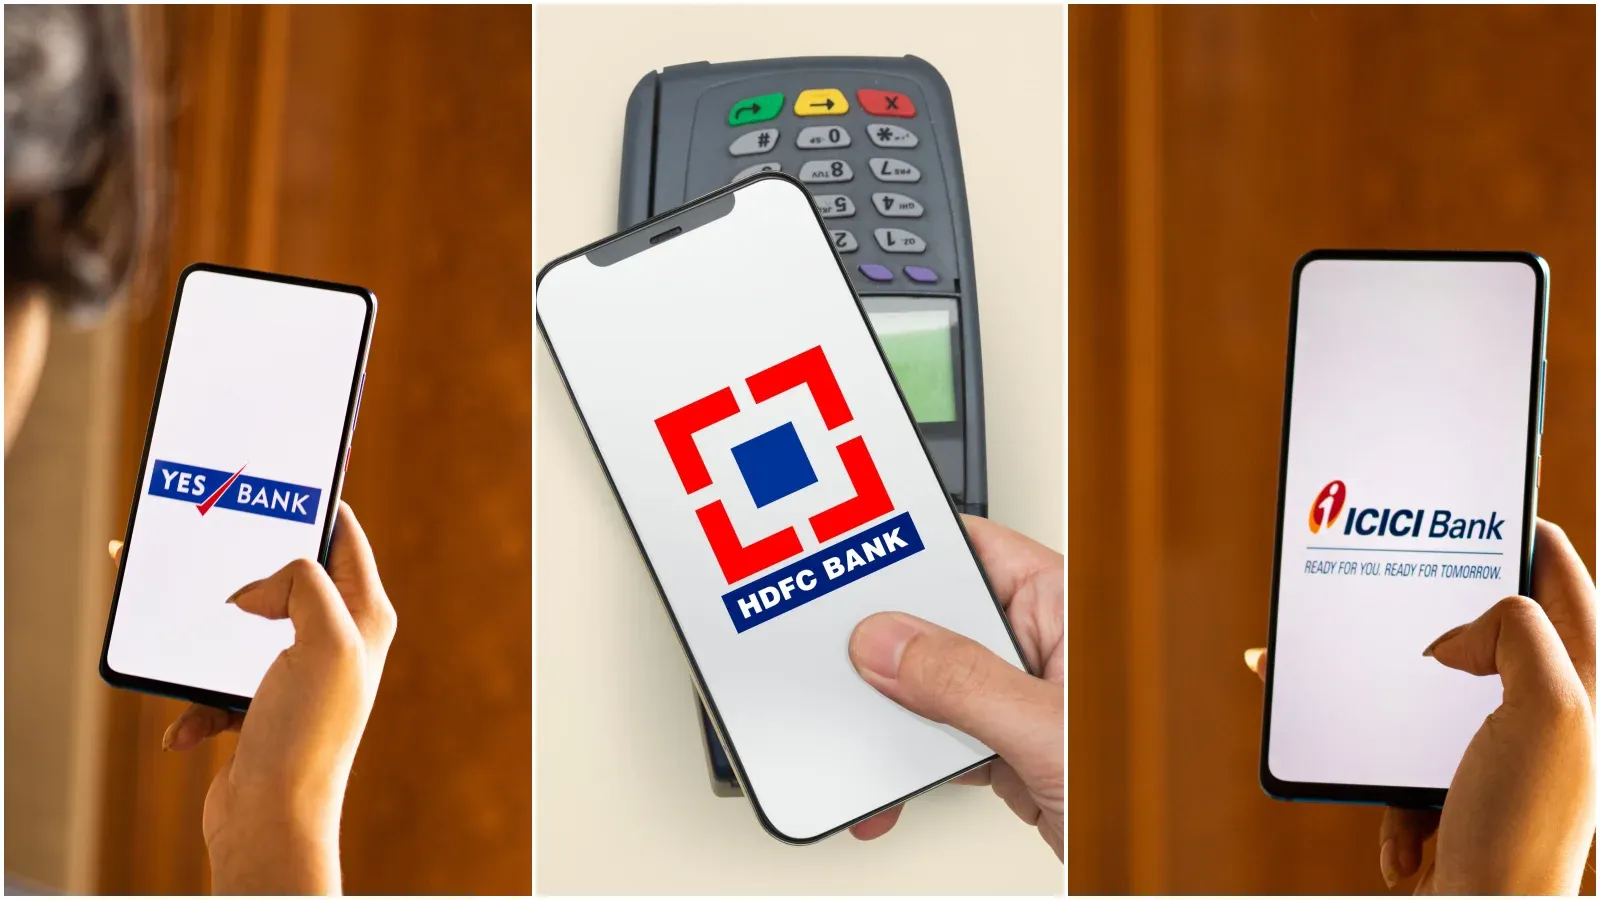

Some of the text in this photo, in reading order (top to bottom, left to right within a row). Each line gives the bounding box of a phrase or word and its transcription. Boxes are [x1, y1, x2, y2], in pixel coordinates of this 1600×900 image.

[828, 128, 841, 143] 0
[830, 161, 844, 178] 8
[881, 160, 892, 175] 7
[834, 197, 847, 213] 5
[882, 196, 895, 211] 4
[834, 232, 847, 248] 2
[886, 231, 896, 247] 1
[161, 468, 310, 516] YES BANK
[1343, 507, 1425, 538] ICICI
[1428, 510, 1506, 541] Bank
[737, 526, 909, 620] HDFC BANK
[1304, 560, 1502, 580] READY FOR YOU. READY FOR TOMORROW.
